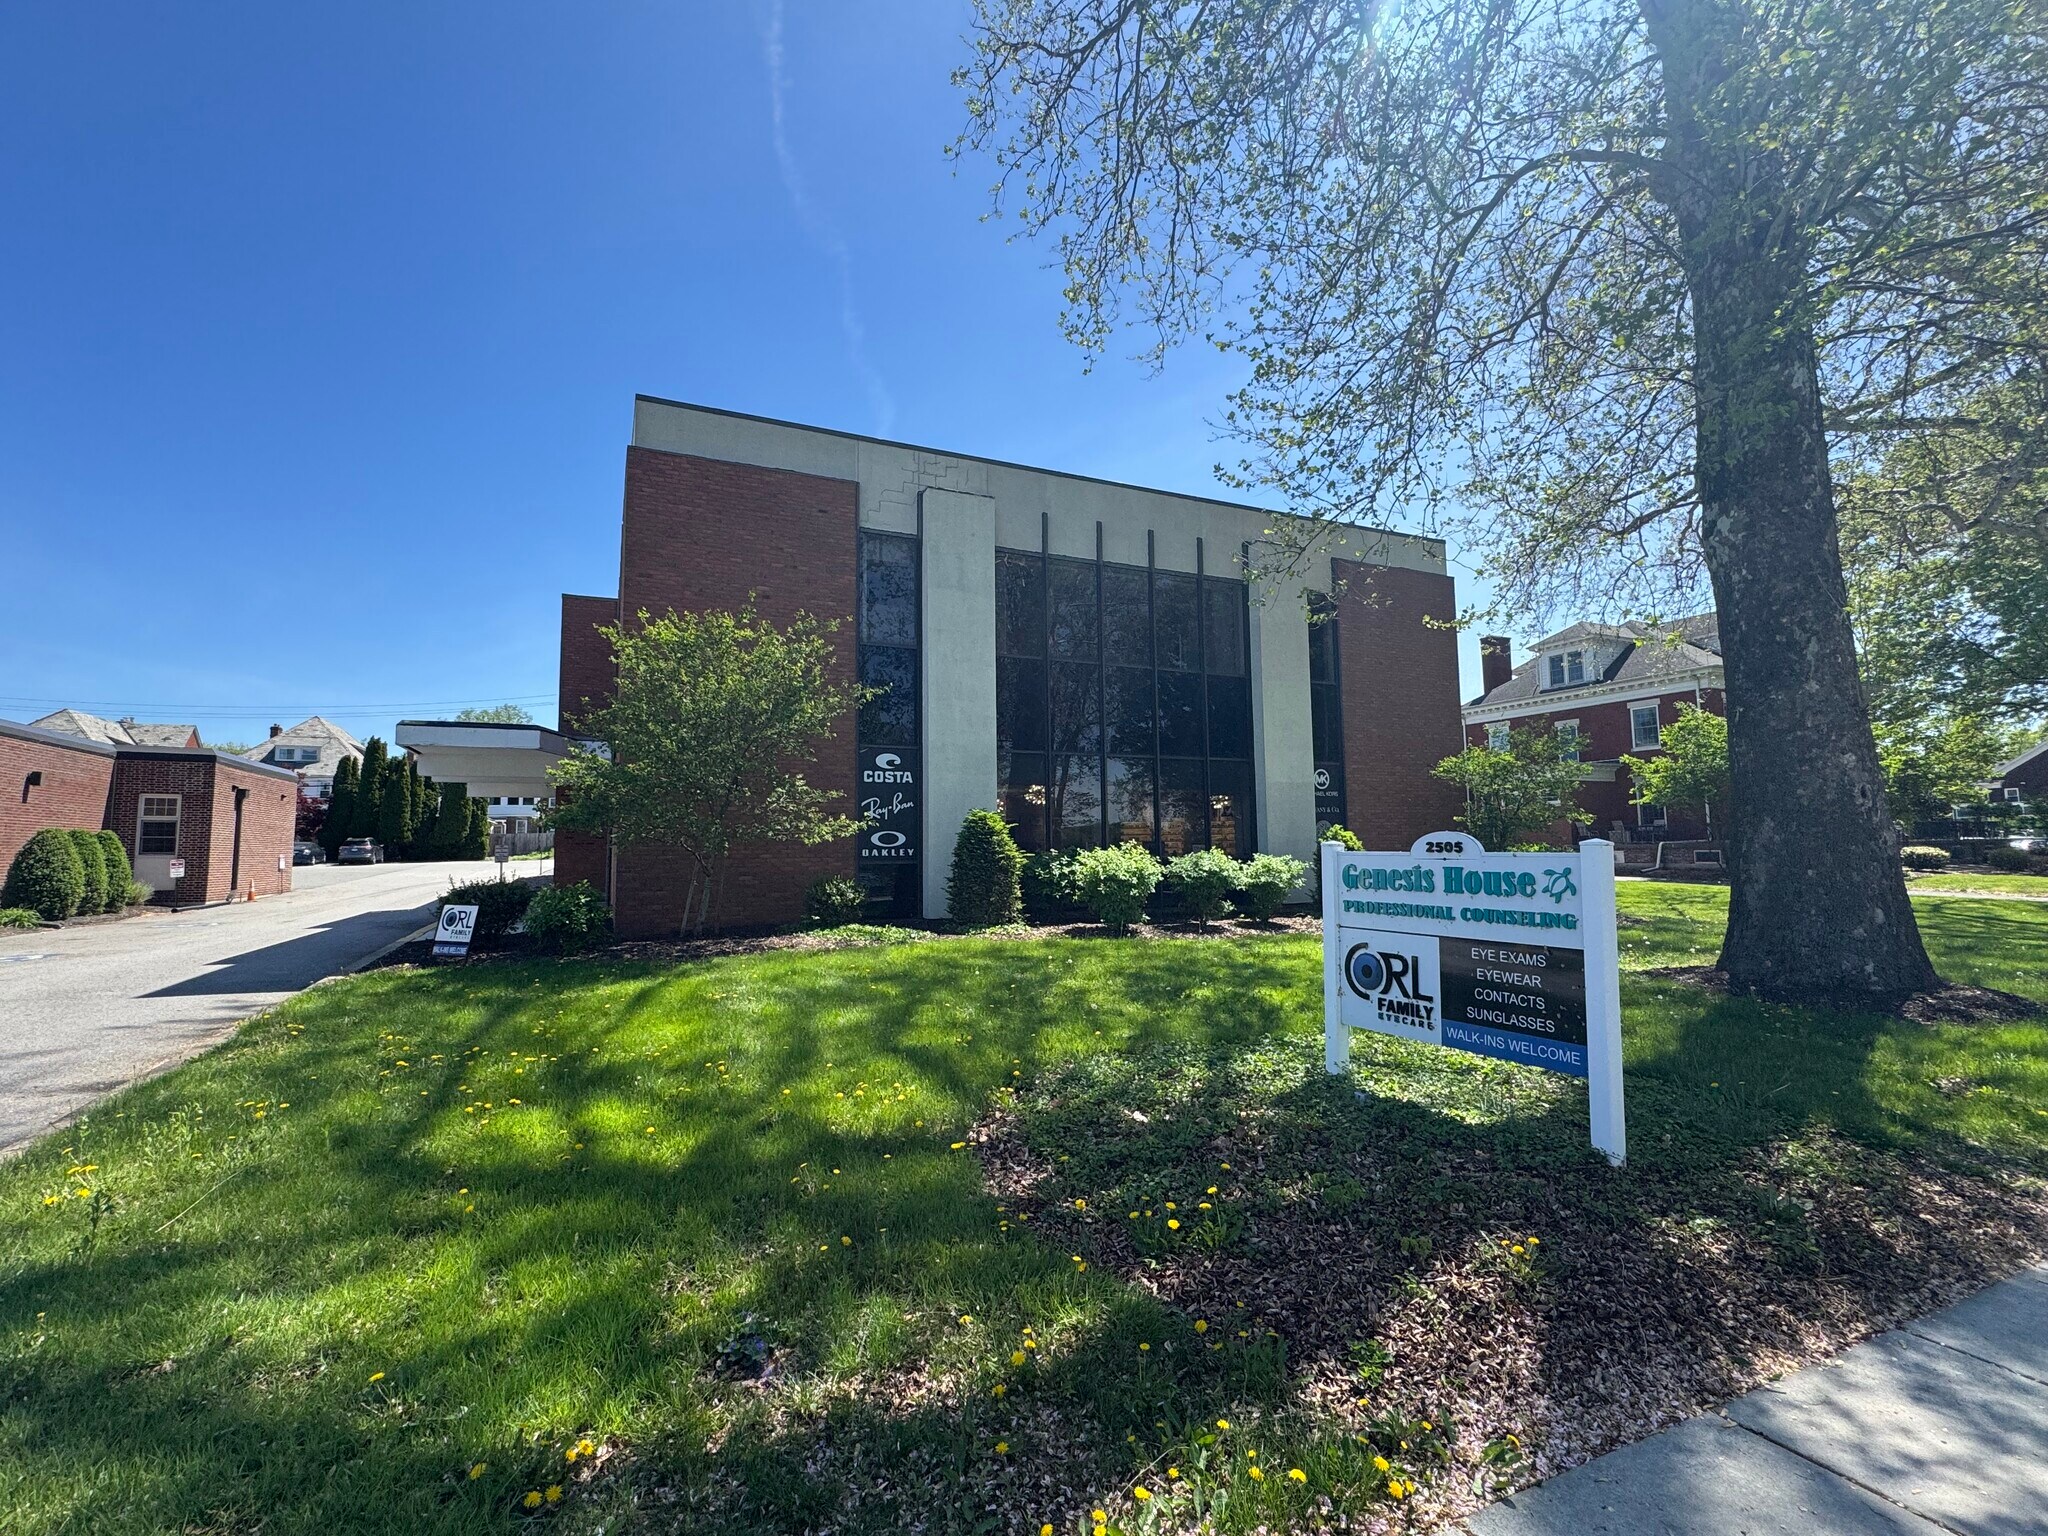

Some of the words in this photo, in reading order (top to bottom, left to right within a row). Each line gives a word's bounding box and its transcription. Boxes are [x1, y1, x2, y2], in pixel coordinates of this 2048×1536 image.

[863, 770, 913, 783] COSTA
[861, 792, 914, 820] Ray-Ban
[862, 848, 915, 857] OAKLEY
[1426, 841, 1464, 854] 2505
[1342, 863, 1436, 893] Genesis
[1443, 866, 1536, 897] House
[1343, 899, 1456, 920] PROFESSIONAL
[1460, 907, 1578, 930] COUNSELING
[1471, 947, 1497, 962] EYE
[1499, 950, 1547, 967] EXAMS
[1476, 968, 1542, 988] EYEWEAR
[1377, 997, 1434, 1020] FAMILY
[1474, 987, 1545, 1010] CONTACTS
[1377, 1011, 1435, 1031] EYECARE
[1466, 1006, 1555, 1033] SUNGLASSES
[1446, 1027, 1505, 1049] WALK-INS
[1508, 1039, 1581, 1066] WELCOME
